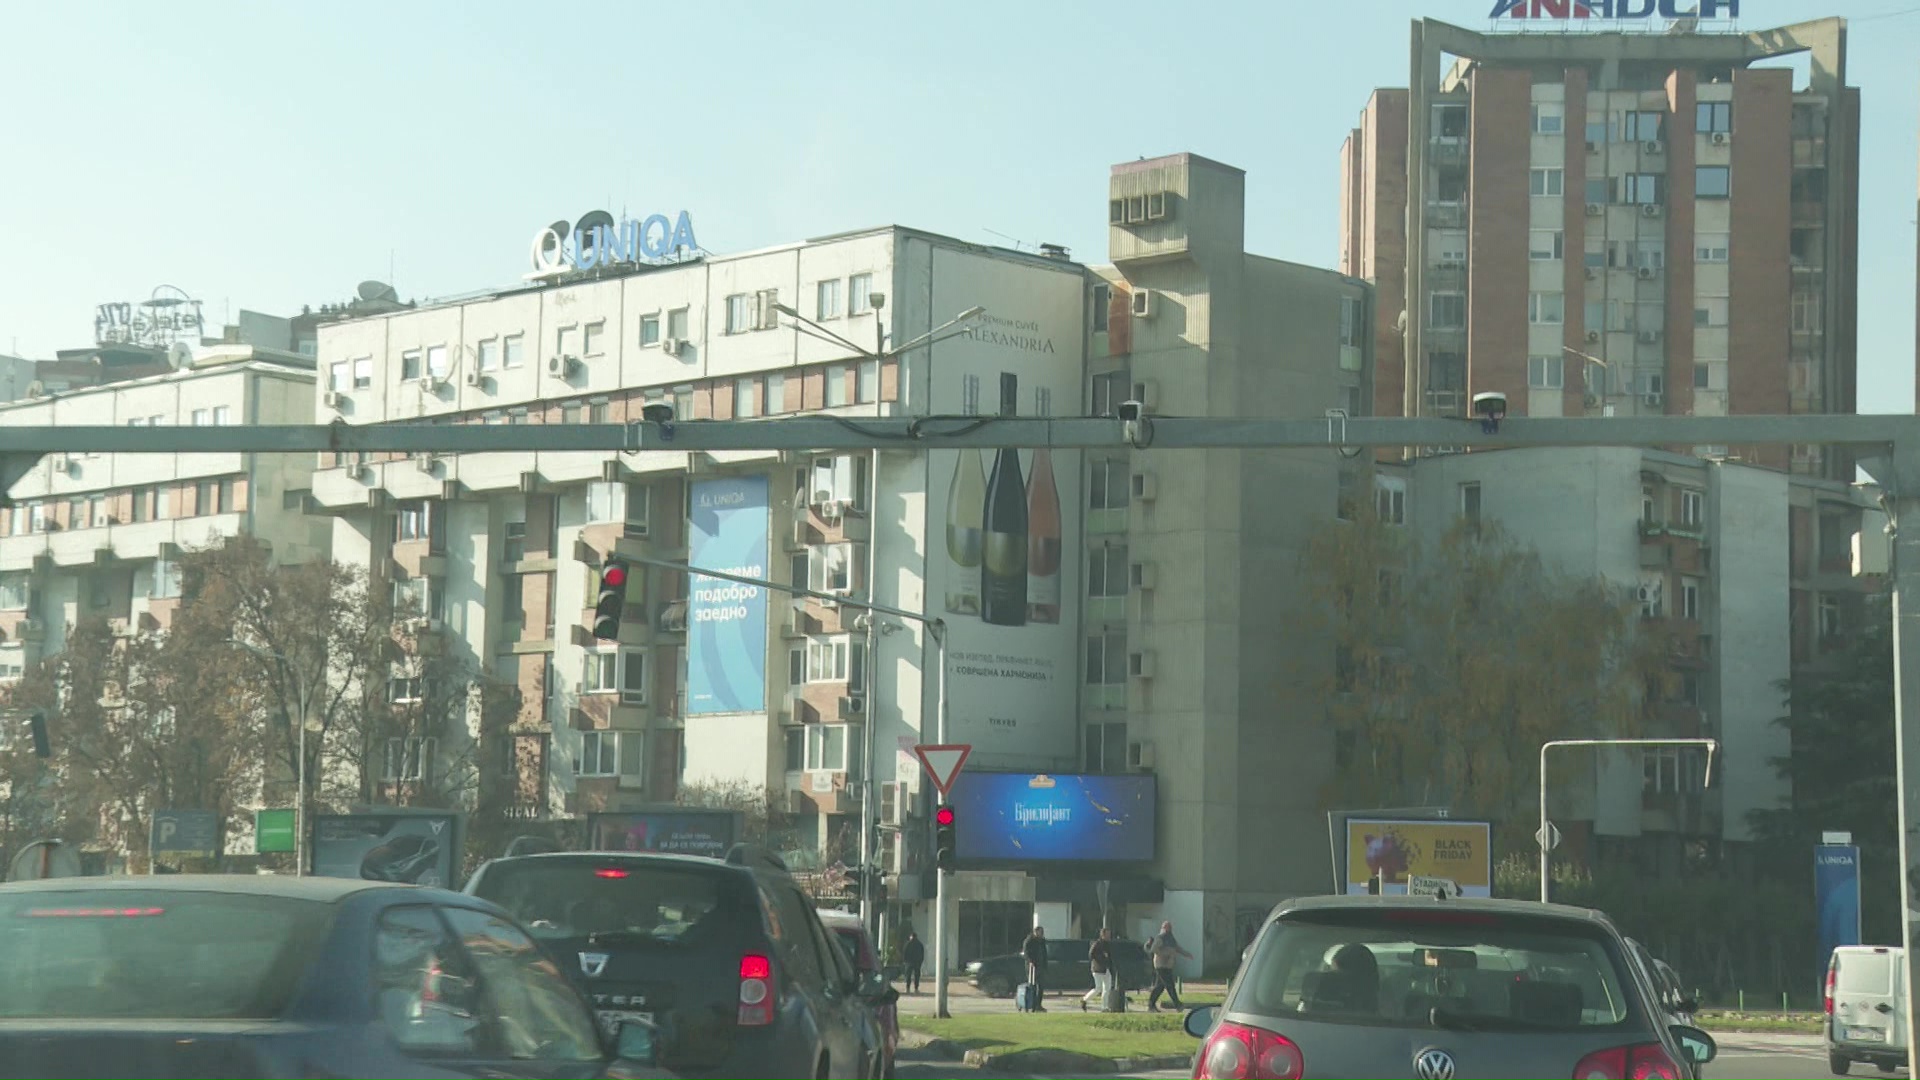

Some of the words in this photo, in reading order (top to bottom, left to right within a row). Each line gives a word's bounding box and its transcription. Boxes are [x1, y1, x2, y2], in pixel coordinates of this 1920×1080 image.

[575, 210, 697, 270] UNIQA
[962, 328, 1055, 353] ALEXANDRIA
[695, 583, 757, 603] подобро
[696, 606, 747, 622] заедно
[1015, 803, 1071, 826] Брилијант
[1435, 839, 1472, 849] BLACK
[1434, 850, 1472, 860] FRIDAY
[1824, 856, 1854, 865] UNIQA
